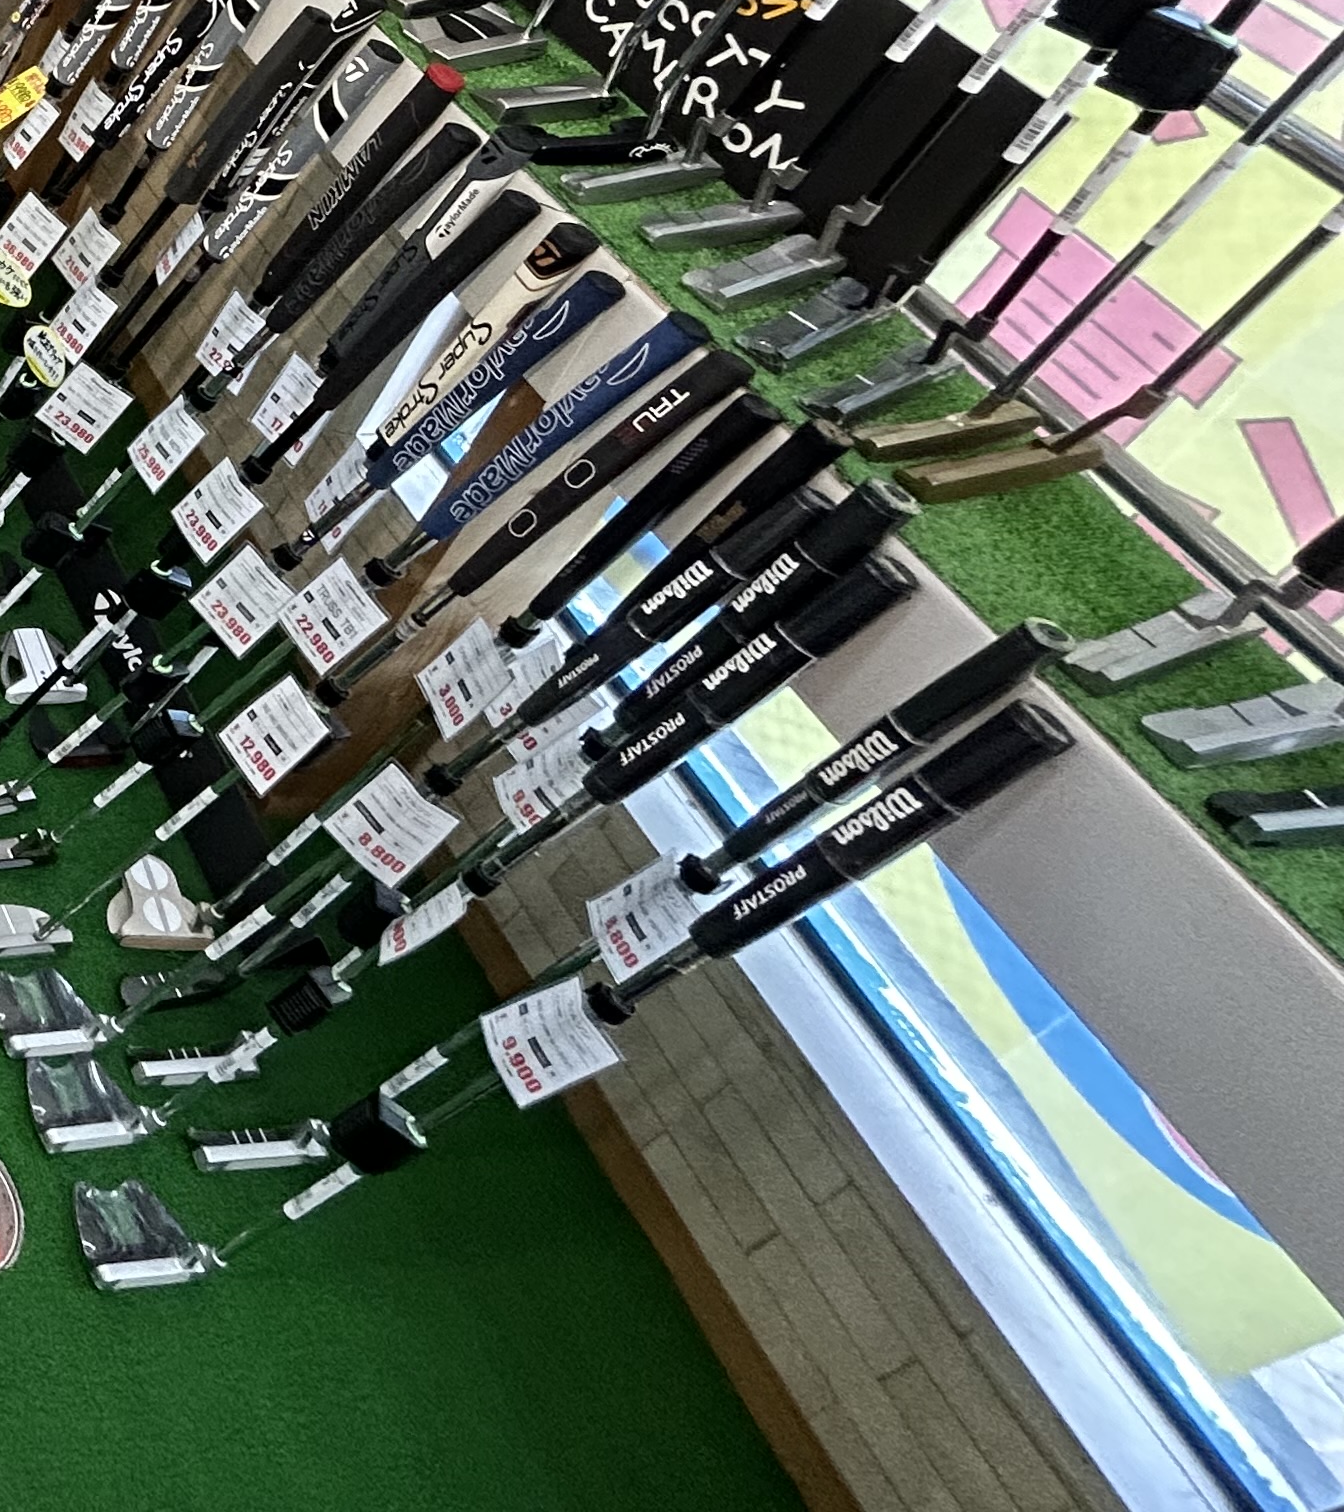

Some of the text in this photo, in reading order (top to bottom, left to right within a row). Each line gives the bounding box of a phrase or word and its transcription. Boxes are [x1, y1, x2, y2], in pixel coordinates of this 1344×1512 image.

[434, 188, 480, 239] TaylorMade
[640, 558, 715, 618] Wilson
[730, 550, 801, 615] Wilson
[701, 630, 778, 694] Wilson
[618, 711, 687, 769] PROSTAFF
[817, 729, 899, 789] Wilson
[830, 784, 925, 849] Wilson
[732, 863, 808, 922] PROSTAFF
